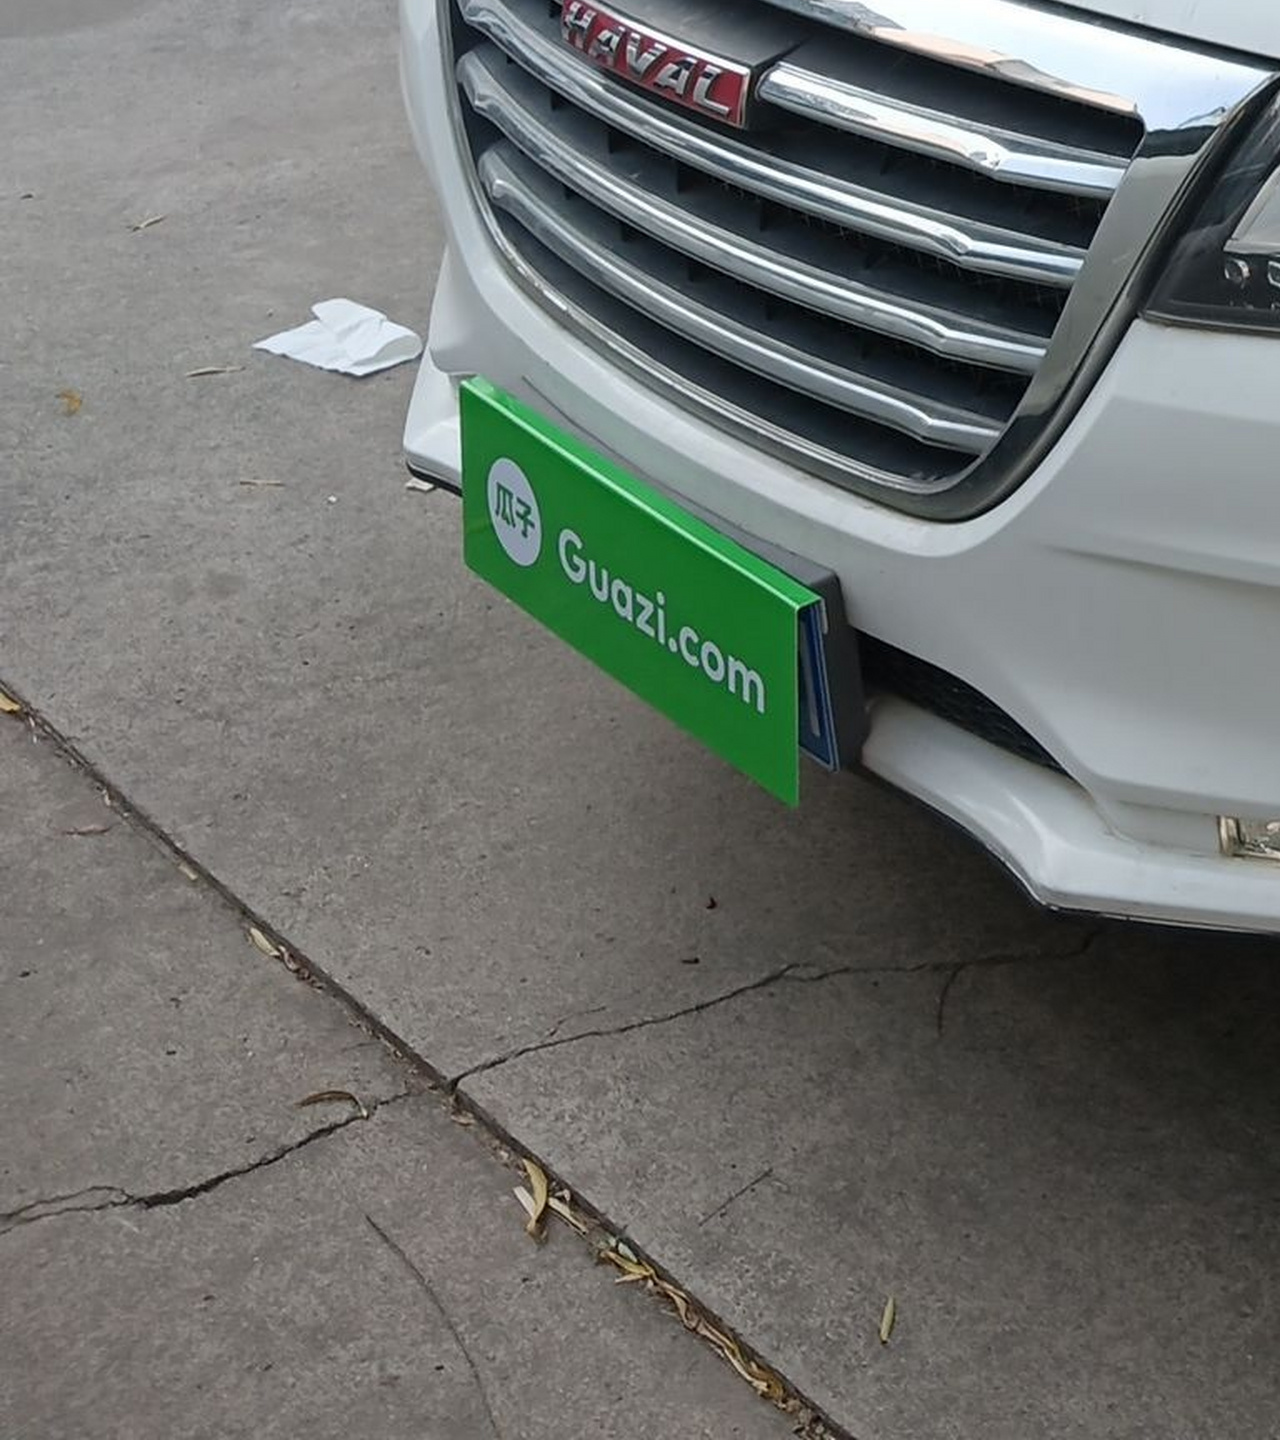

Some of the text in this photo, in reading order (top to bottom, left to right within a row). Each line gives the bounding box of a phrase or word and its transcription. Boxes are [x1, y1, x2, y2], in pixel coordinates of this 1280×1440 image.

[562, 0, 731, 117] HAVAL
[495, 482, 536, 539] 瓜子
[558, 527, 765, 714] Guazi.com
